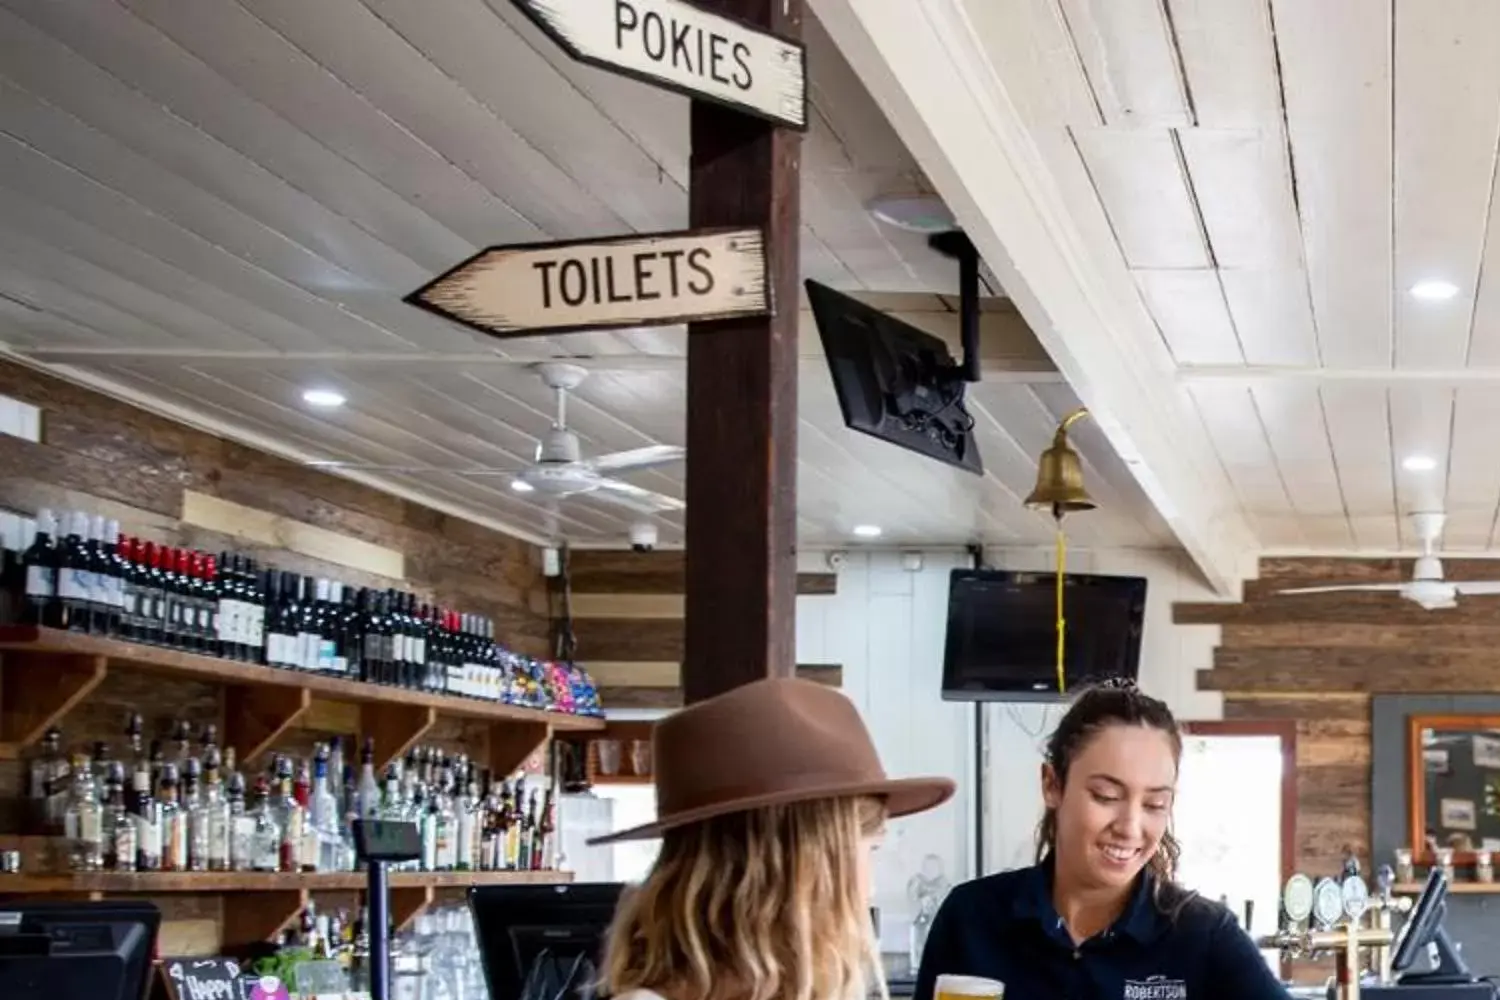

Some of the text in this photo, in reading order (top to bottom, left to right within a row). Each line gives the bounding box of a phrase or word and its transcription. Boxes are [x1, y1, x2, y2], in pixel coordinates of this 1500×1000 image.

[616, 1, 753, 91] POKIES
[533, 248, 714, 309] TOILETS
[185, 975, 234, 1000] HAPPY
[1125, 984, 1187, 1000] ROBERTSON
